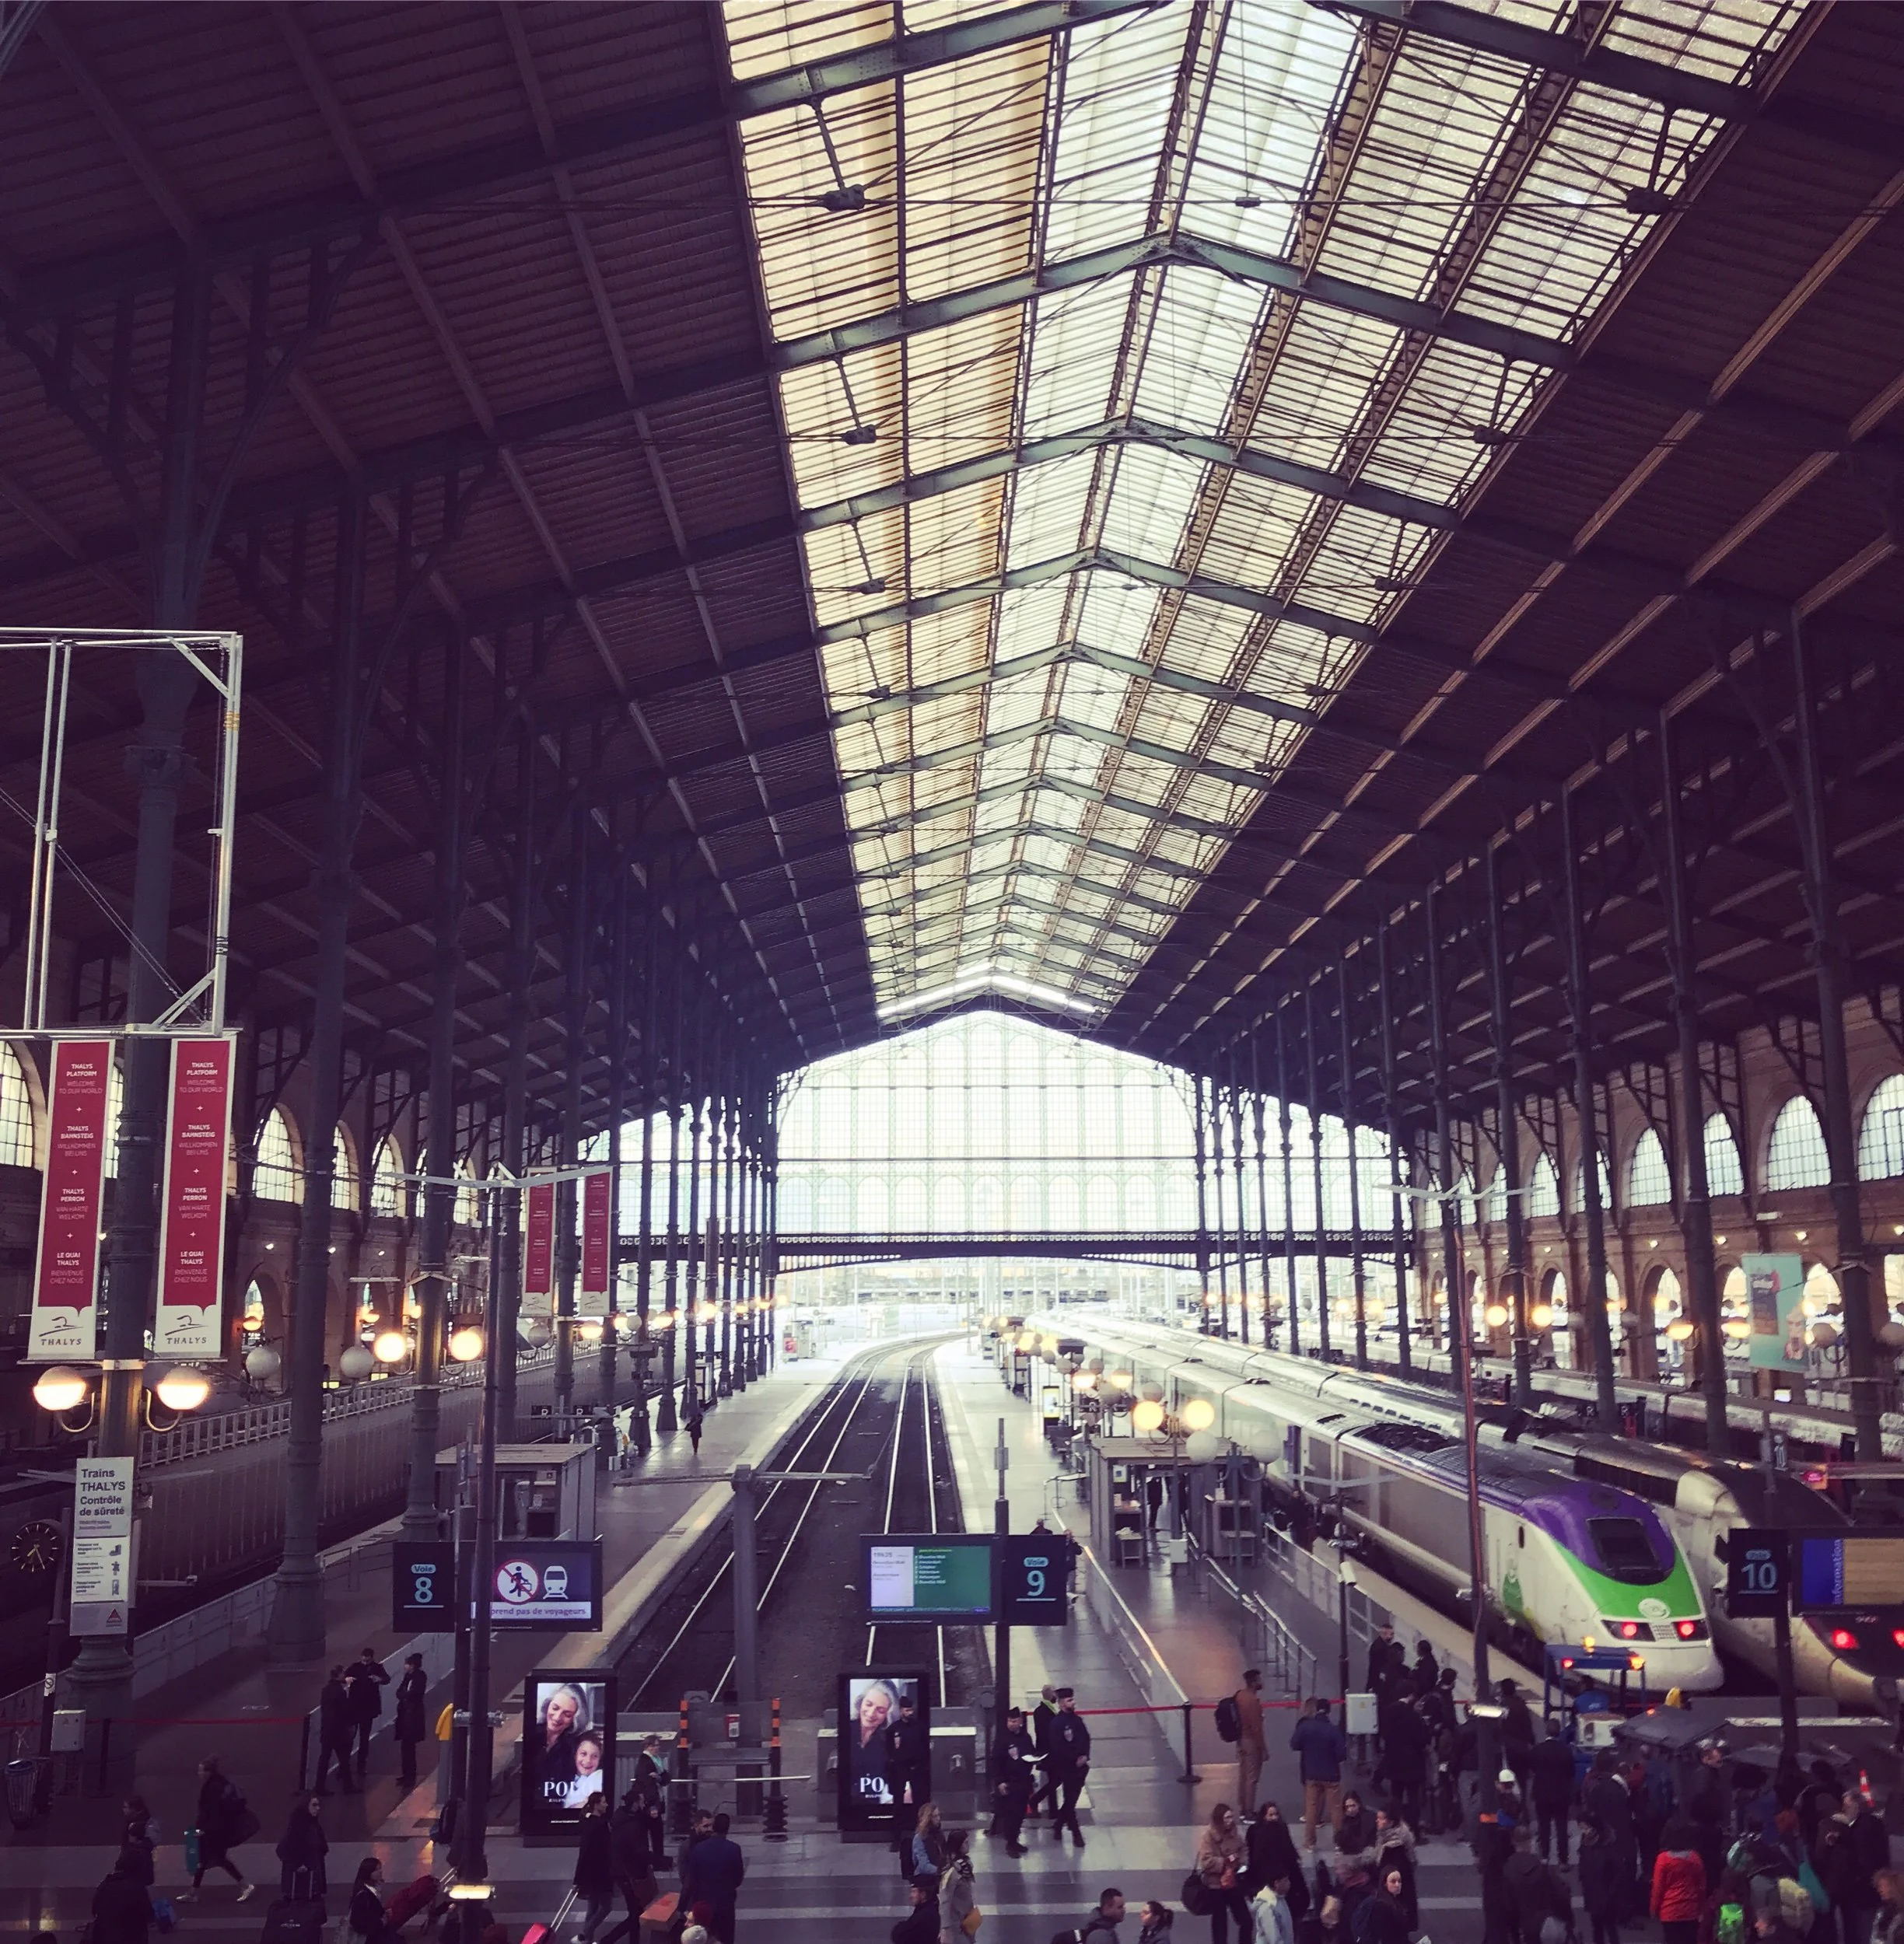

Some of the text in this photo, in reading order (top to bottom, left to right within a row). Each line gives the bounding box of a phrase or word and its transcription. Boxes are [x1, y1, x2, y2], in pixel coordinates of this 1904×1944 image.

[81, 1468, 115, 1478] Trains
[80, 1481, 126, 1491] THALYS
[80, 1495, 122, 1505] Contrôle
[93, 1506, 125, 1516] sûreté
[1741, 1563, 1776, 1589] 10
[1027, 1570, 1045, 1596] 9
[415, 1576, 433, 1603] 8
